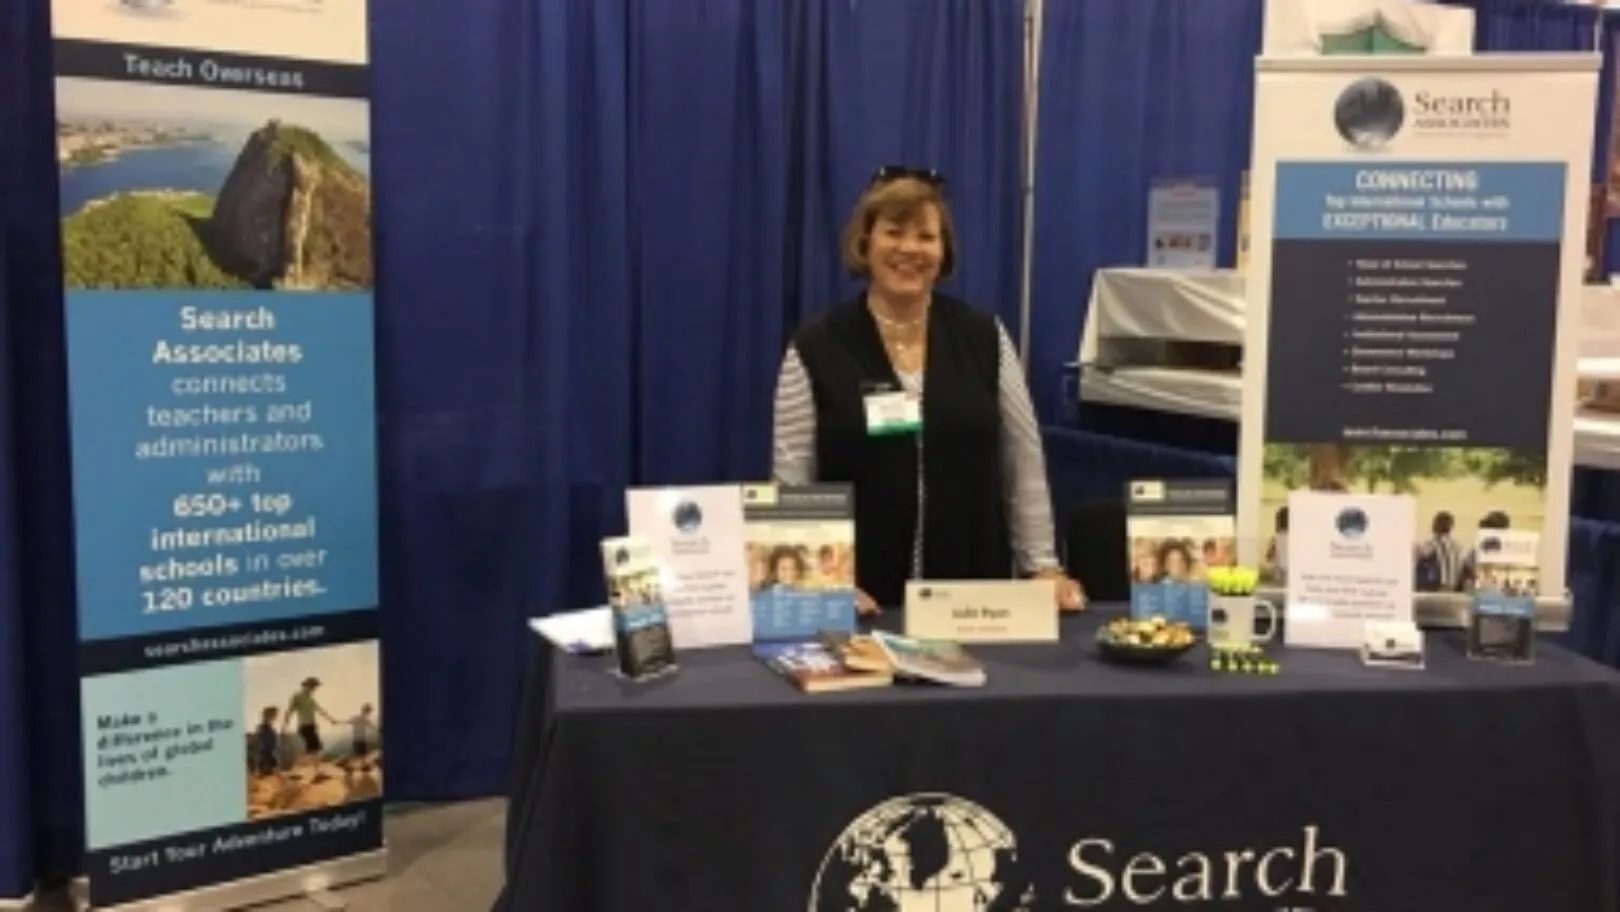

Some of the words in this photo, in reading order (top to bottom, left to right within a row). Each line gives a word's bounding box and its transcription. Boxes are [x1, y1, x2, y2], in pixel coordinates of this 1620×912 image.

[123, 53, 193, 78] Teach
[1414, 88, 1511, 116] Search
[1354, 169, 1480, 191] CONNECTING
[1321, 212, 1427, 231] EXCEPTIONAL
[1432, 213, 1508, 231] Educators
[179, 305, 276, 330] Search
[152, 339, 304, 364] Associates
[171, 372, 286, 396] connects
[147, 404, 258, 427] teachers
[266, 401, 312, 424] and
[135, 430, 325, 459] administrators
[206, 464, 261, 484] with
[172, 493, 242, 517] 650+
[251, 492, 292, 516] top
[151, 515, 316, 550] international
[140, 553, 239, 582] schools
[246, 552, 270, 572] in
[276, 549, 328, 569] over
[141, 587, 193, 614] 120
[202, 576, 328, 606] countries.
[97, 711, 142, 730] Make
[96, 727, 182, 750] difference
[187, 721, 204, 735] in
[140, 746, 159, 762] of
[165, 738, 215, 761] global
[109, 850, 160, 875] Start
[164, 840, 206, 862] Your
[211, 823, 303, 854] Adventure
[1063, 825, 1349, 905] Search
